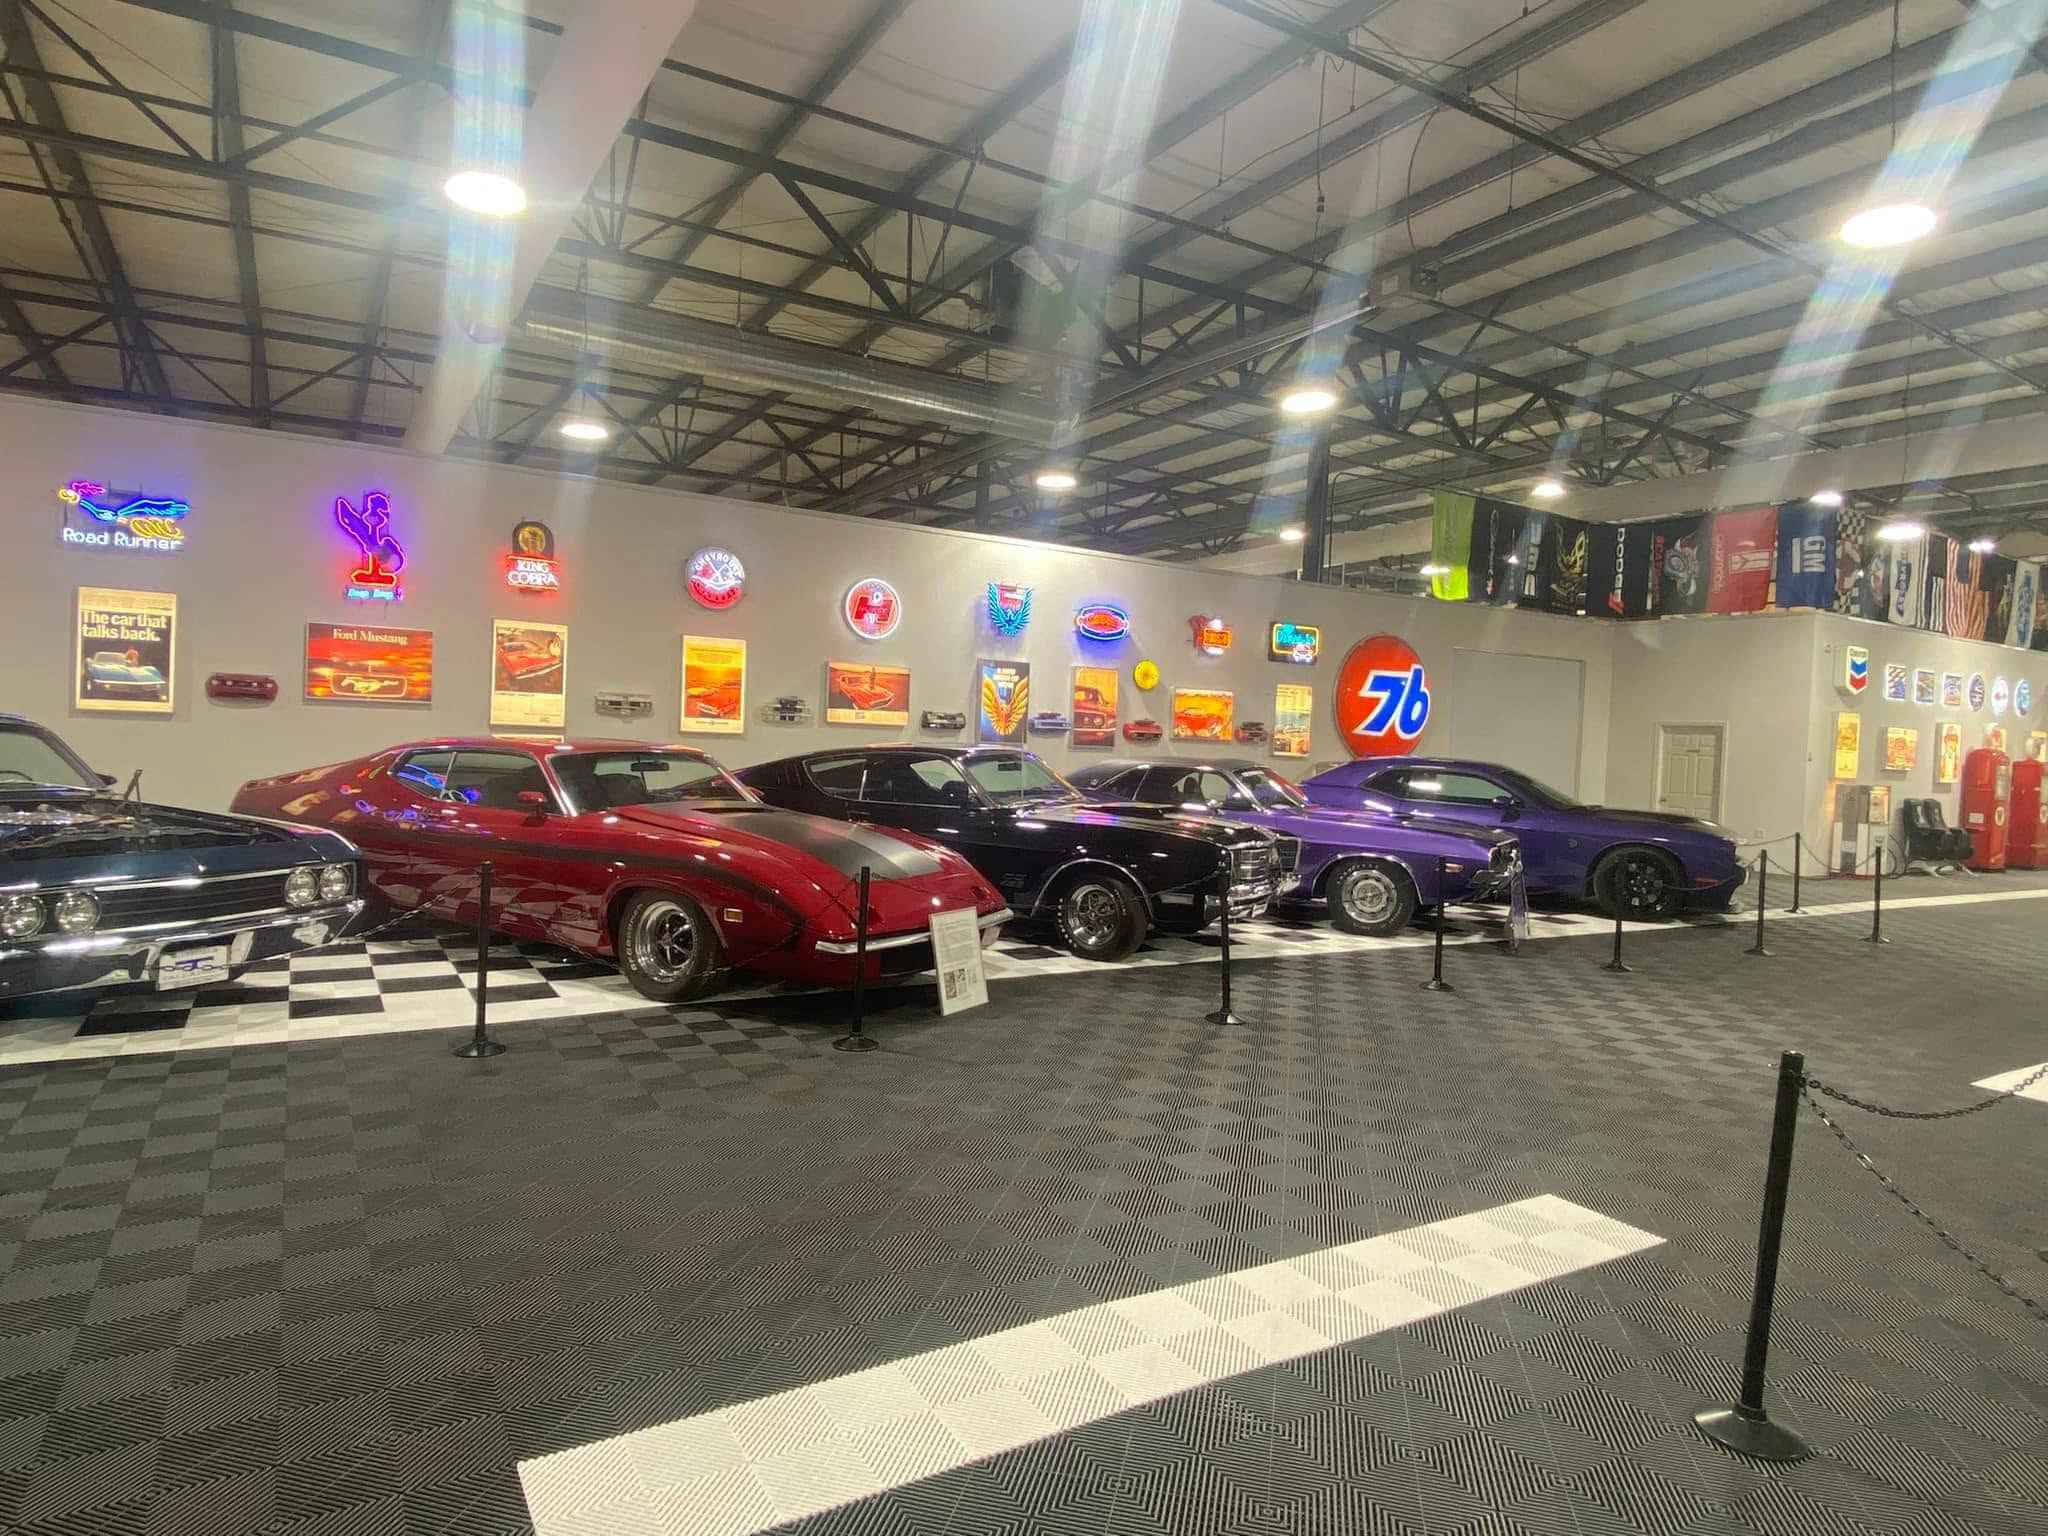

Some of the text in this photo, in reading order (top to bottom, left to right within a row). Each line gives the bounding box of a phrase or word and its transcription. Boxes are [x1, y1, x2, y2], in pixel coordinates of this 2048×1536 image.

[63, 527, 184, 550] Road Runner
[1803, 535, 1826, 573] GM
[515, 558, 550, 573] KING
[507, 570, 559, 586] COBRA
[82, 610, 168, 629] The car that
[81, 623, 161, 642] talks back.
[333, 628, 408, 646] Ford Mustang
[1351, 663, 1431, 740] 76
